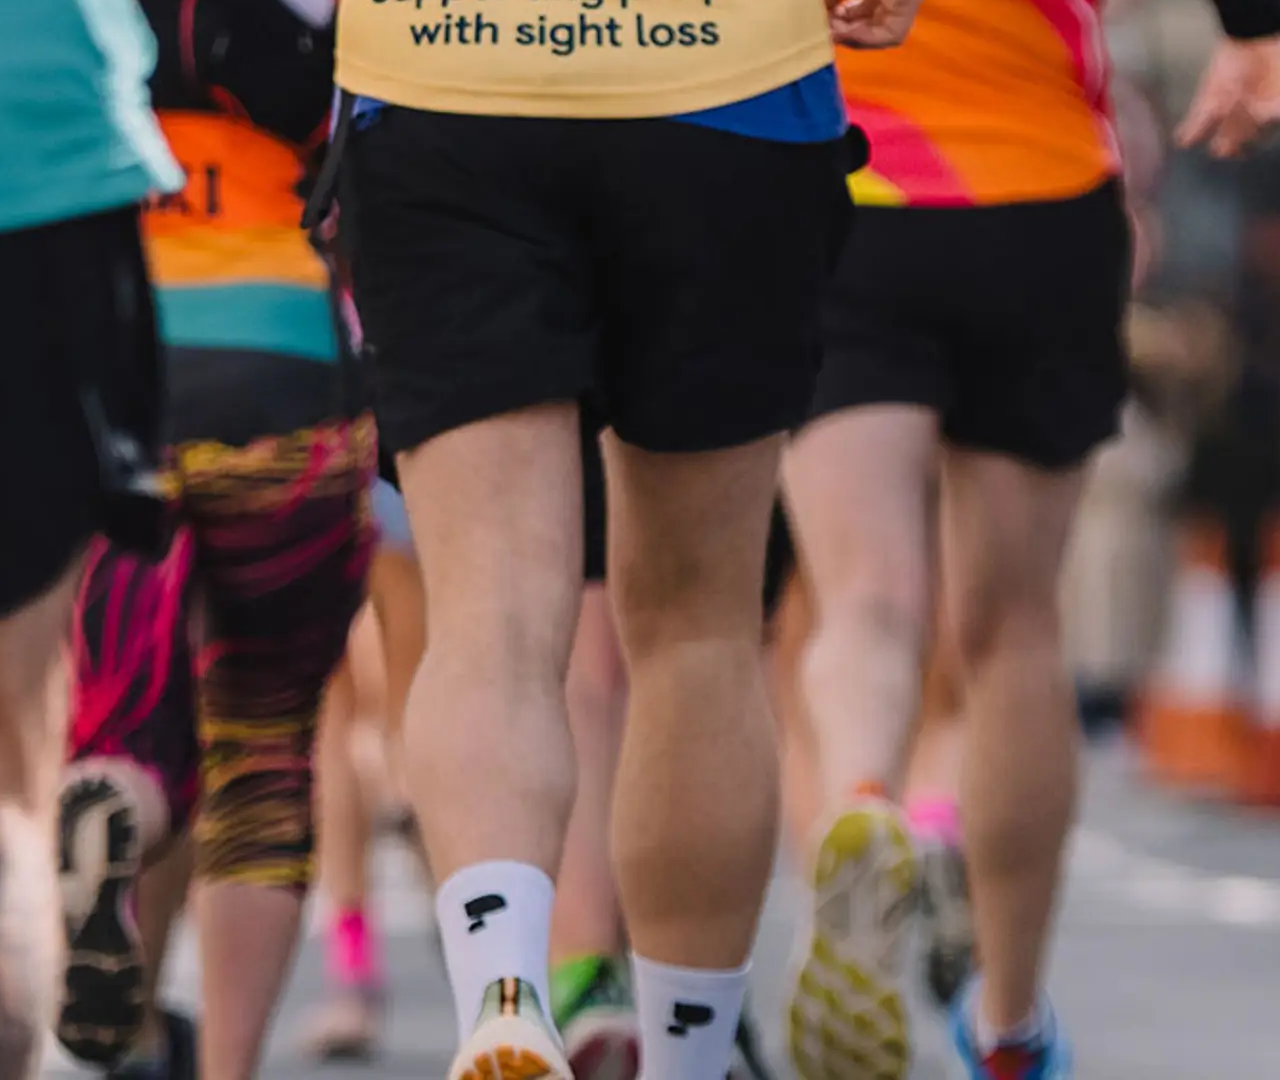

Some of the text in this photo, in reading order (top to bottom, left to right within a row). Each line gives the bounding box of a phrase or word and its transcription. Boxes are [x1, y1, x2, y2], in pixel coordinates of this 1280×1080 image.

[409, 13, 720, 56] with sight loss
